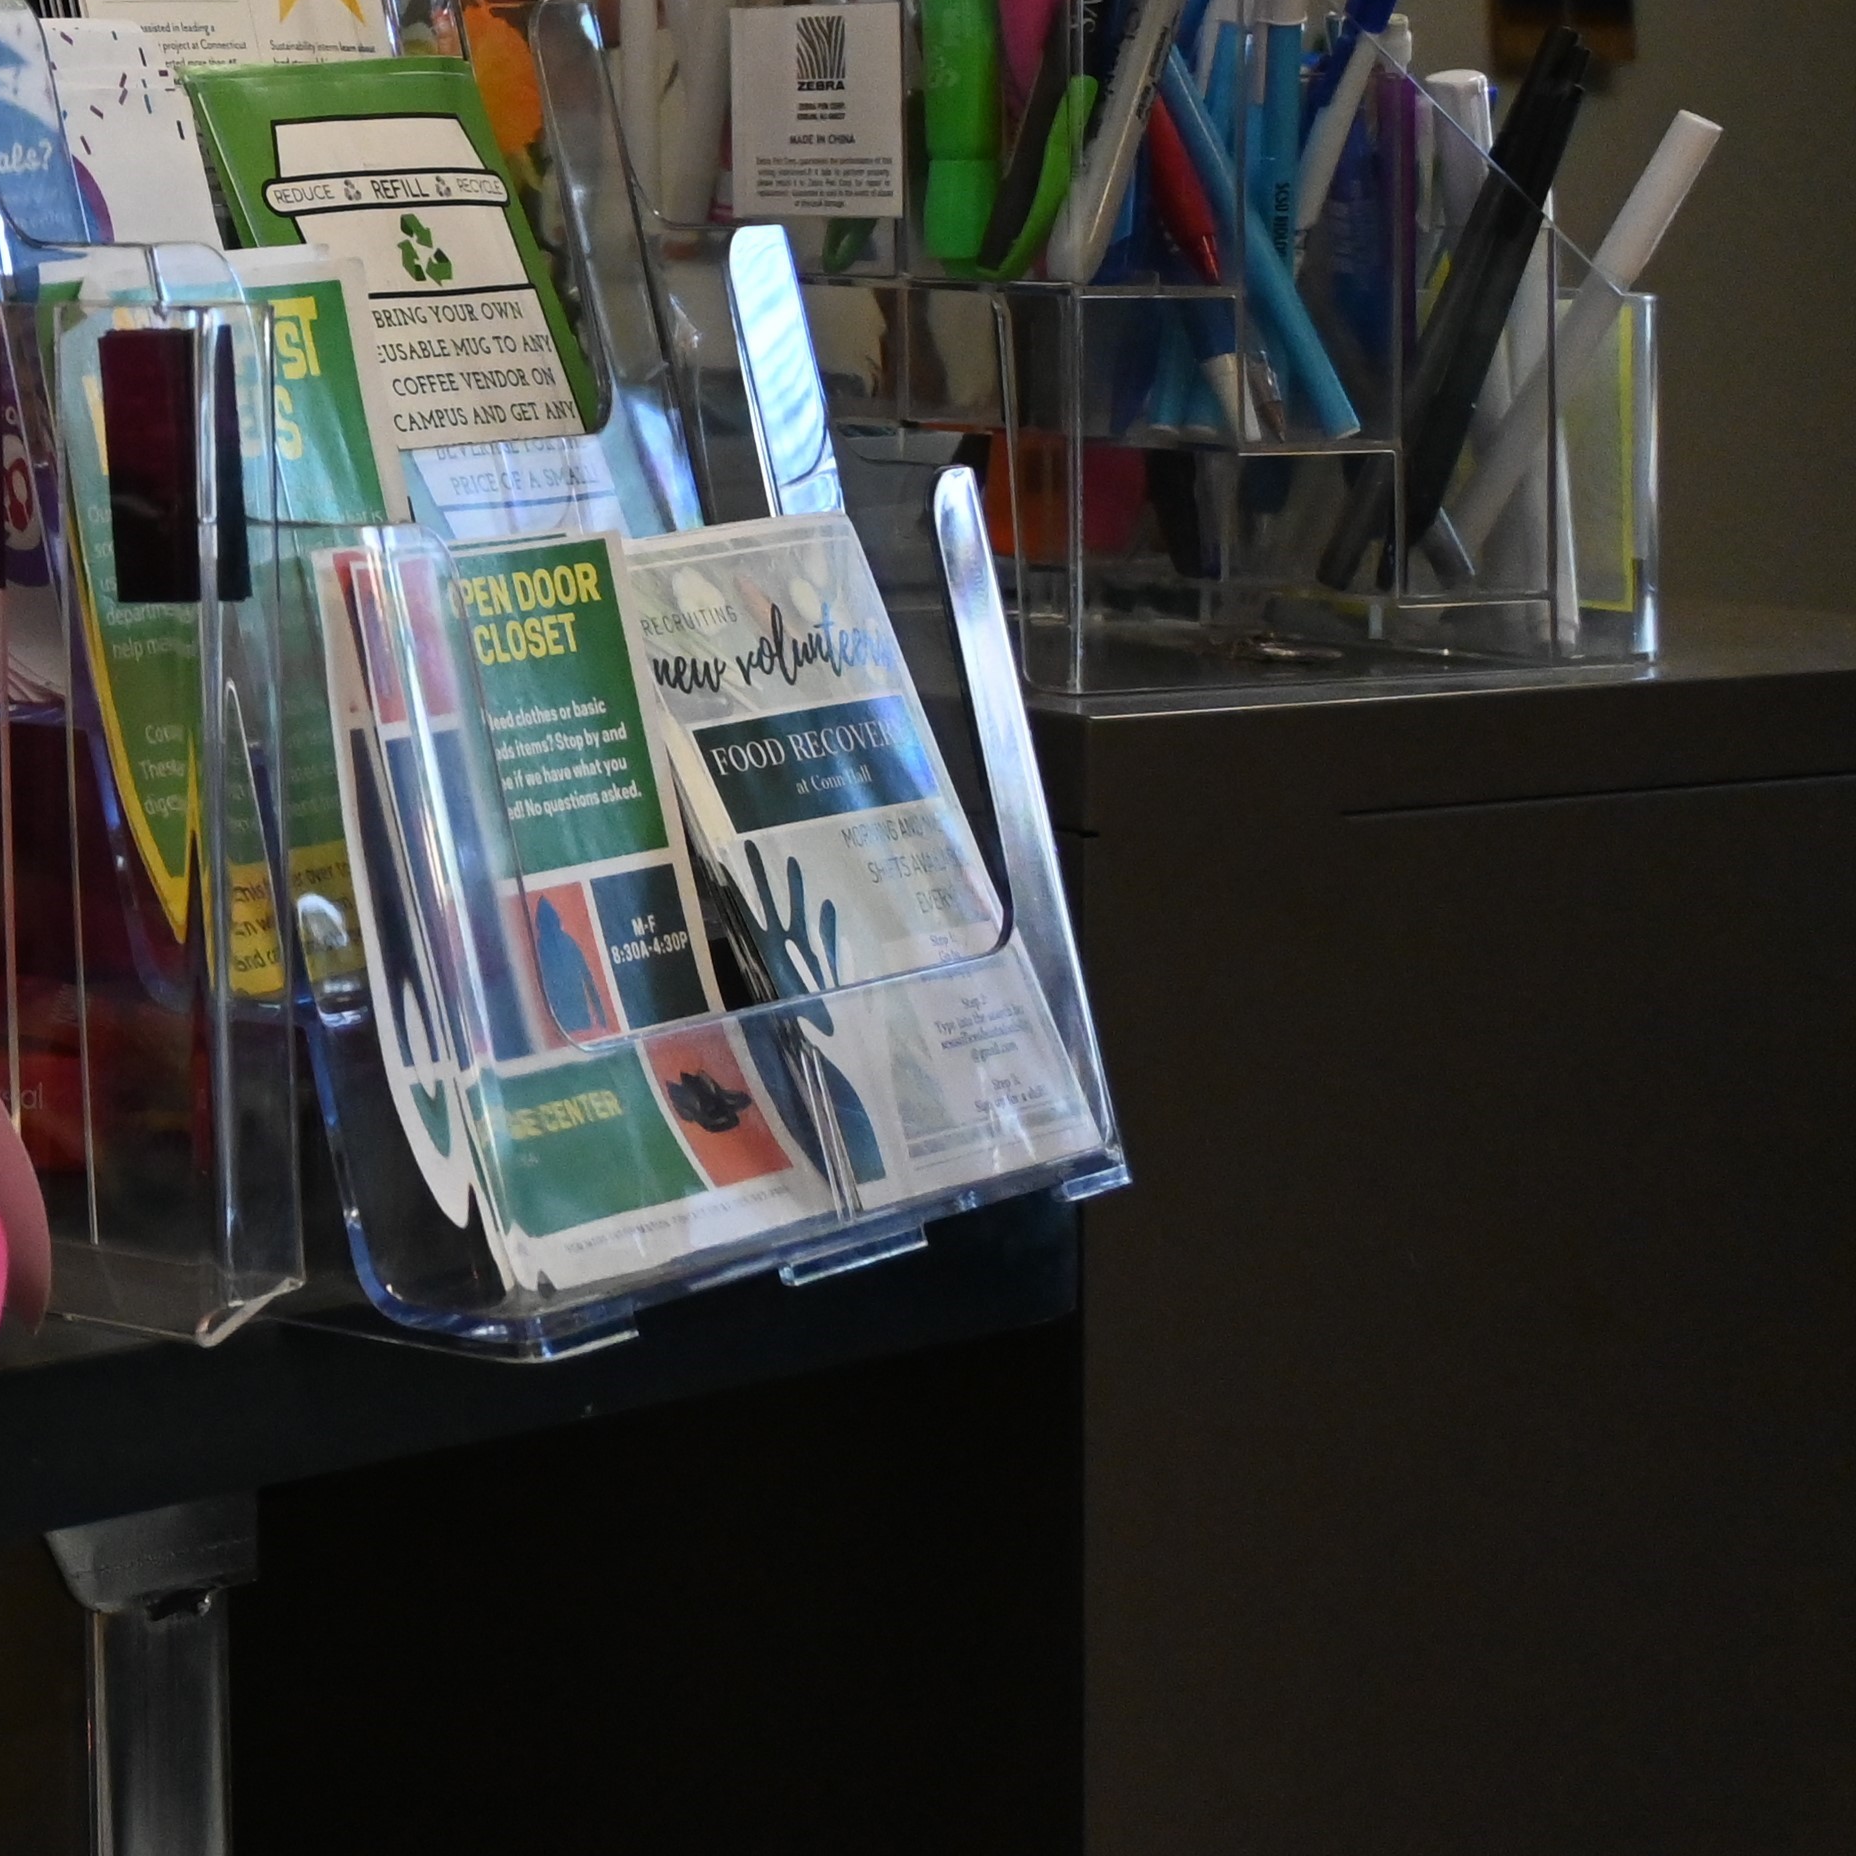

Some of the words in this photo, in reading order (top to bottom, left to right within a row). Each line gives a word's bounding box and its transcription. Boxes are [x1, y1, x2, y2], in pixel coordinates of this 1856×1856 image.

[172, 23, 180, 32] in
[181, 22, 210, 36] leading
[163, 42, 191, 54] project
[192, 42, 198, 50] at
[200, 39, 247, 50] Connecticut
[270, 40, 315, 54] Sustainability
[340, 43, 356, 52] learn
[797, 81, 845, 91] ZEBRA
[790, 135, 813, 144] MADE
[817, 135, 826, 144] IN
[828, 134, 856, 144] CHINA
[273, 184, 335, 204] REDUCE
[371, 178, 430, 199] REFILL
[456, 177, 504, 195] RECYCLE
[372, 306, 428, 329] BRING
[428, 303, 479, 324] YOUR
[480, 301, 524, 321] OWN
[450, 336, 492, 358] MUG
[492, 335, 517, 354] TO
[522, 334, 554, 353] ANY
[392, 372, 459, 397] COFFEE
[460, 368, 531, 391] VENDOR
[531, 367, 556, 388] ON
[393, 407, 468, 432] CAMPUS
[472, 405, 507, 425] AND
[510, 402, 540, 422] GET
[546, 399, 576, 420] ANY
[449, 472, 499, 496] PRICE
[529, 472, 542, 488] A
[512, 563, 601, 612] DOOR
[640, 605, 738, 637] RECRUITING
[473, 612, 578, 667] CLOSET
[653, 655, 726, 694] new
[736, 602, 896, 686] volunteers
[515, 704, 558, 728] clothes
[559, 707, 572, 721] or
[572, 697, 607, 718] basic
[516, 734, 554, 756] items?
[554, 732, 583, 752] Stop
[586, 731, 600, 747] by
[602, 721, 627, 742] and
[710, 737, 786, 776] FOOD
[787, 718, 902, 760] RECOVER
[515, 771, 525, 790] if
[526, 770, 543, 786] we
[544, 765, 572, 785] have
[573, 759, 603, 780] what
[603, 757, 627, 776] you
[796, 781, 809, 795] at
[526, 798, 543, 817] No
[544, 790, 600, 817] questions
[601, 780, 642, 803] asked.
[631, 914, 656, 937] M-F
[611, 932, 688, 965] 8:30A-4:30P
[541, 1090, 623, 1133] CENTER
